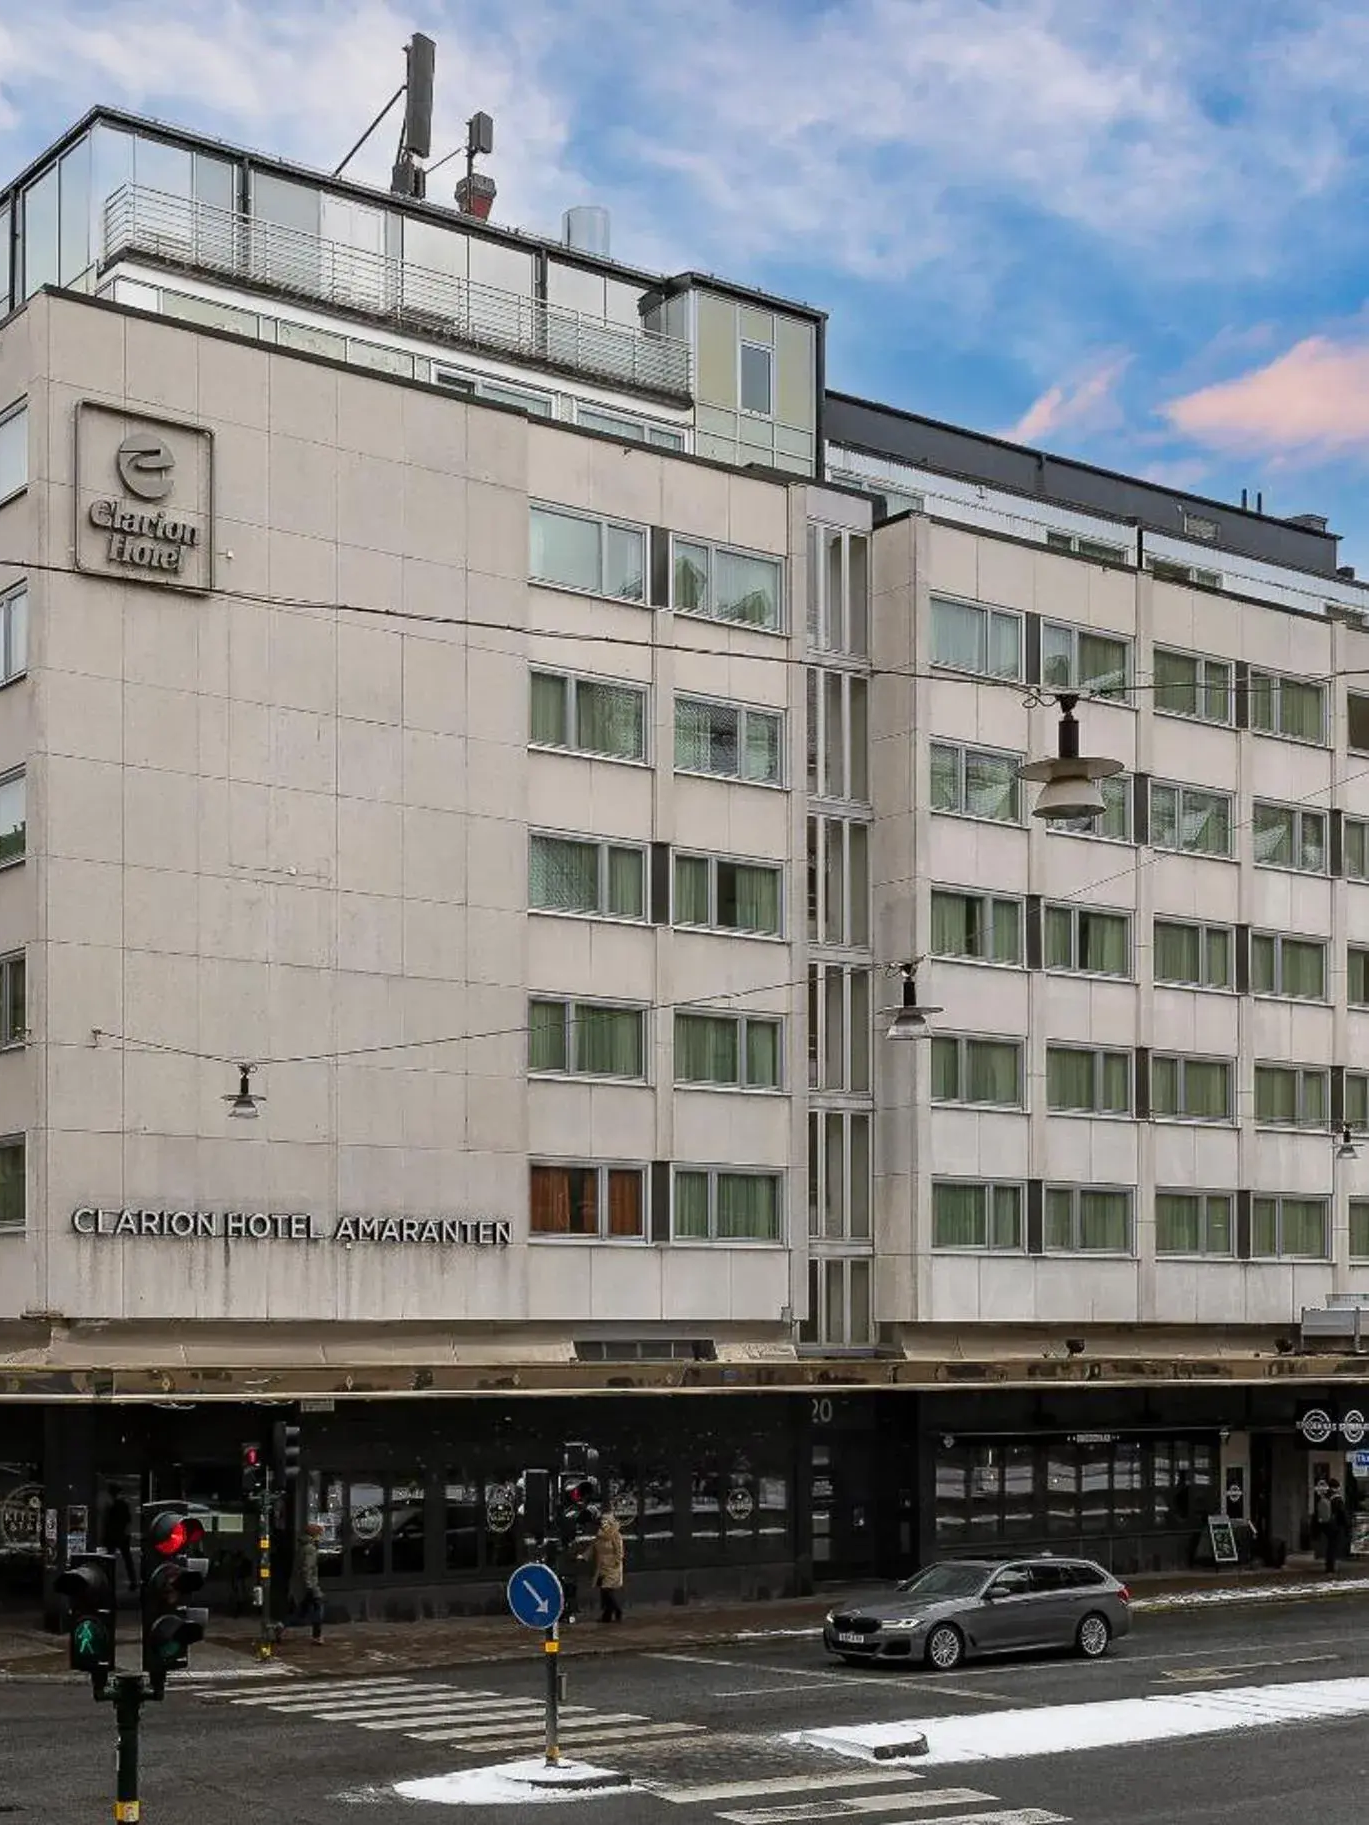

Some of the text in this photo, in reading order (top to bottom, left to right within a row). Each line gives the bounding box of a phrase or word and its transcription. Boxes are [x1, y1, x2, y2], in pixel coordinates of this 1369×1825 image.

[89, 499, 200, 546] Clarion
[107, 532, 189, 573] Hotel
[71, 1206, 514, 1245] CLARION HOTEL AMARANTEN
